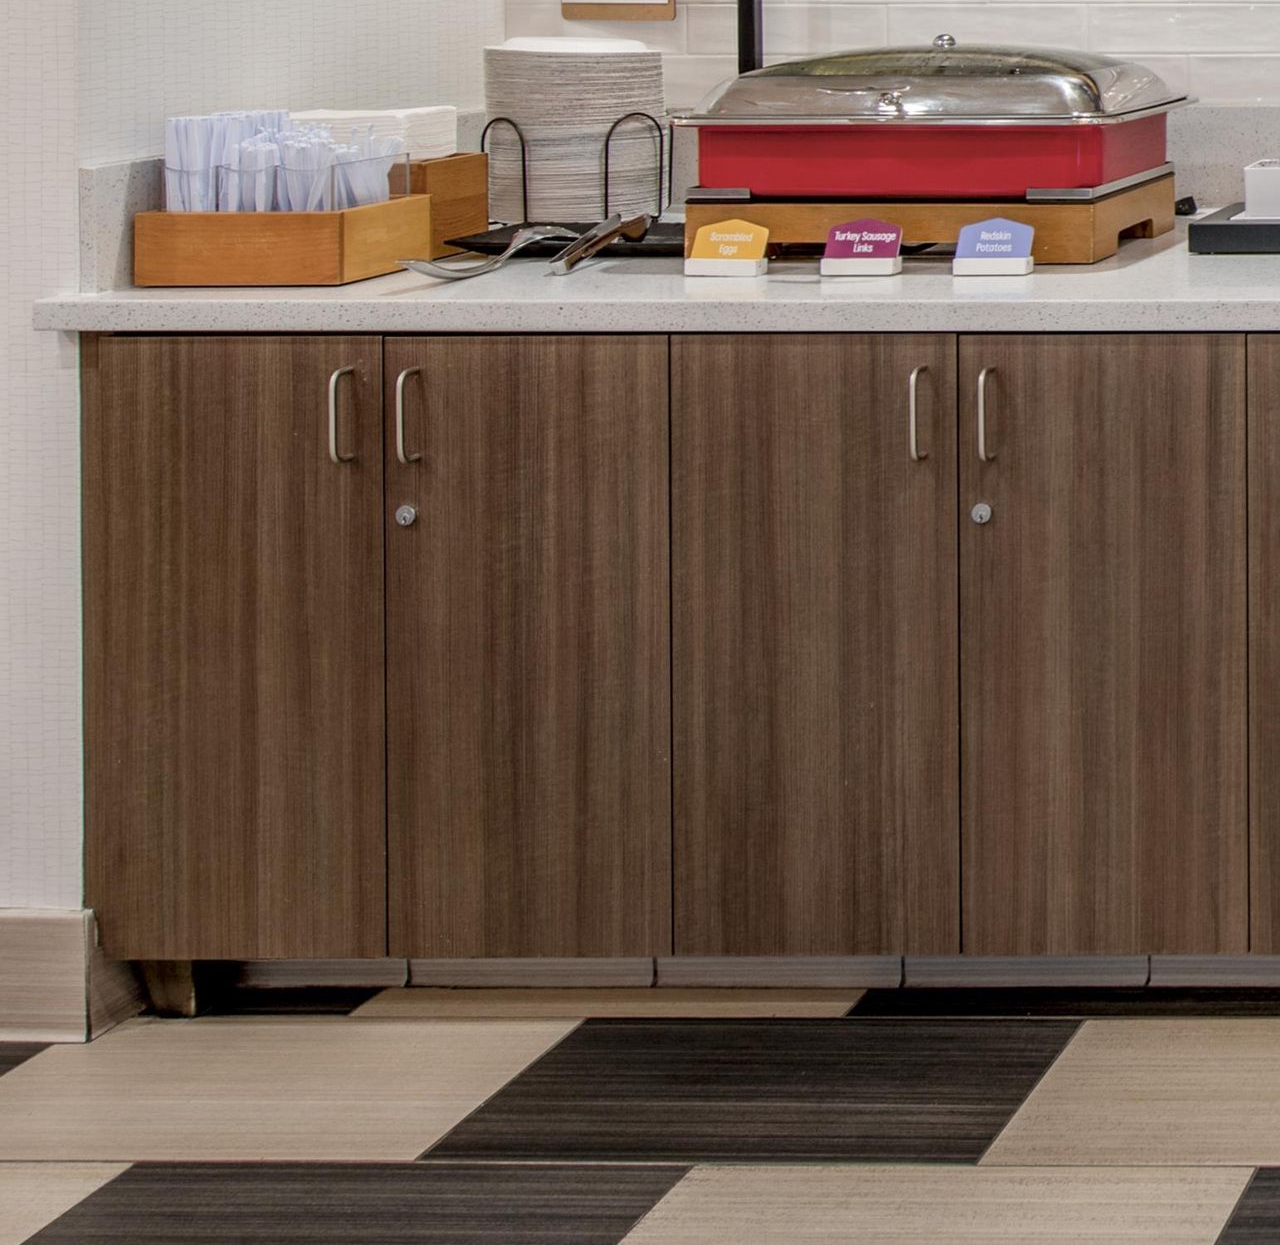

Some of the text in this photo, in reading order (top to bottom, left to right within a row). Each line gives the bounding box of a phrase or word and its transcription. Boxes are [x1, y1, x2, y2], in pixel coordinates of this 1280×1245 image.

[710, 231, 753, 241] Scrambled
[835, 231, 897, 243] Turkey Sausage
[980, 231, 1012, 241] Redskin
[719, 244, 737, 255] Eggs
[853, 243, 874, 253] Links
[976, 243, 1013, 252] Potatoes
